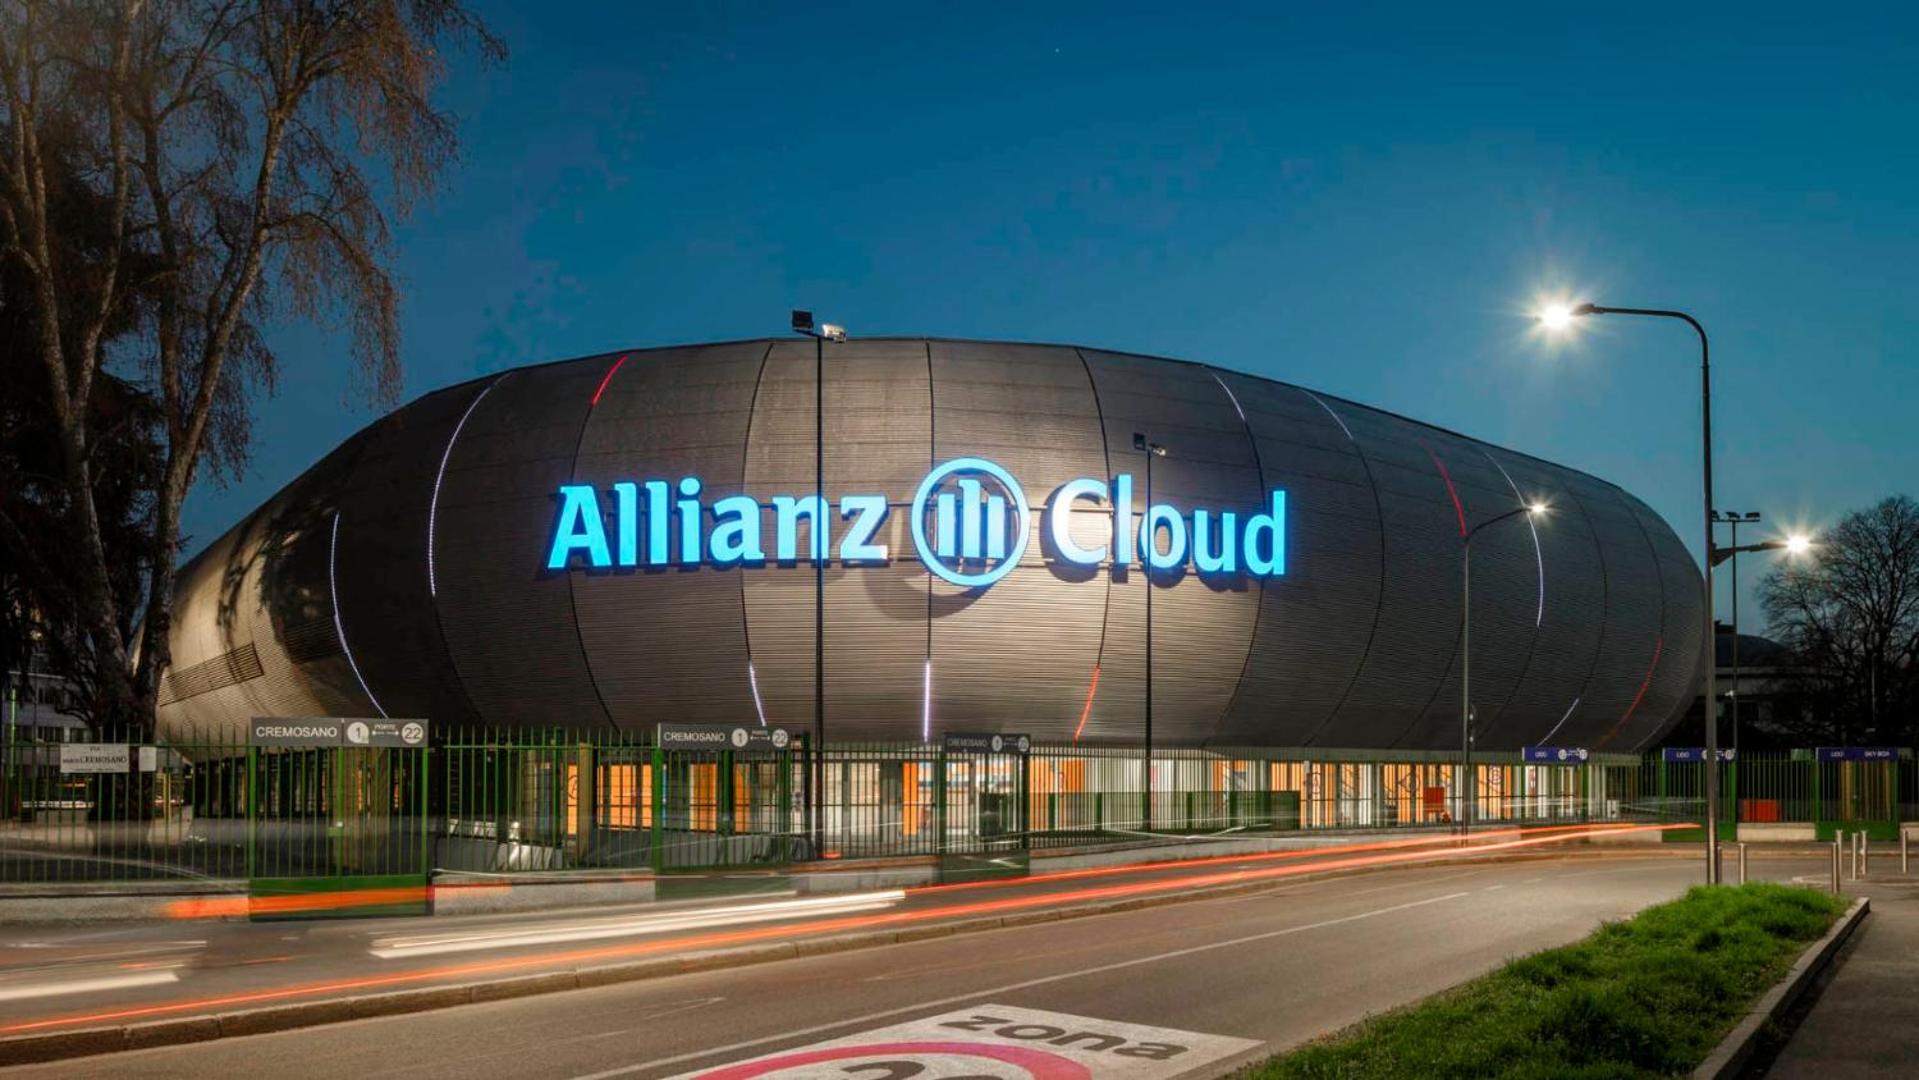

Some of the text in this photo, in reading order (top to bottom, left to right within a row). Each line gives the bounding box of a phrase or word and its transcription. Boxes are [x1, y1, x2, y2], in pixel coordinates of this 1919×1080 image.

[546, 473, 1286, 576] Allianz Cloud
[255, 726, 338, 738] CREMOSANO
[404, 727, 422, 740] 22
[663, 731, 726, 742] CREMOSANO
[938, 1015, 1190, 1061] zona
